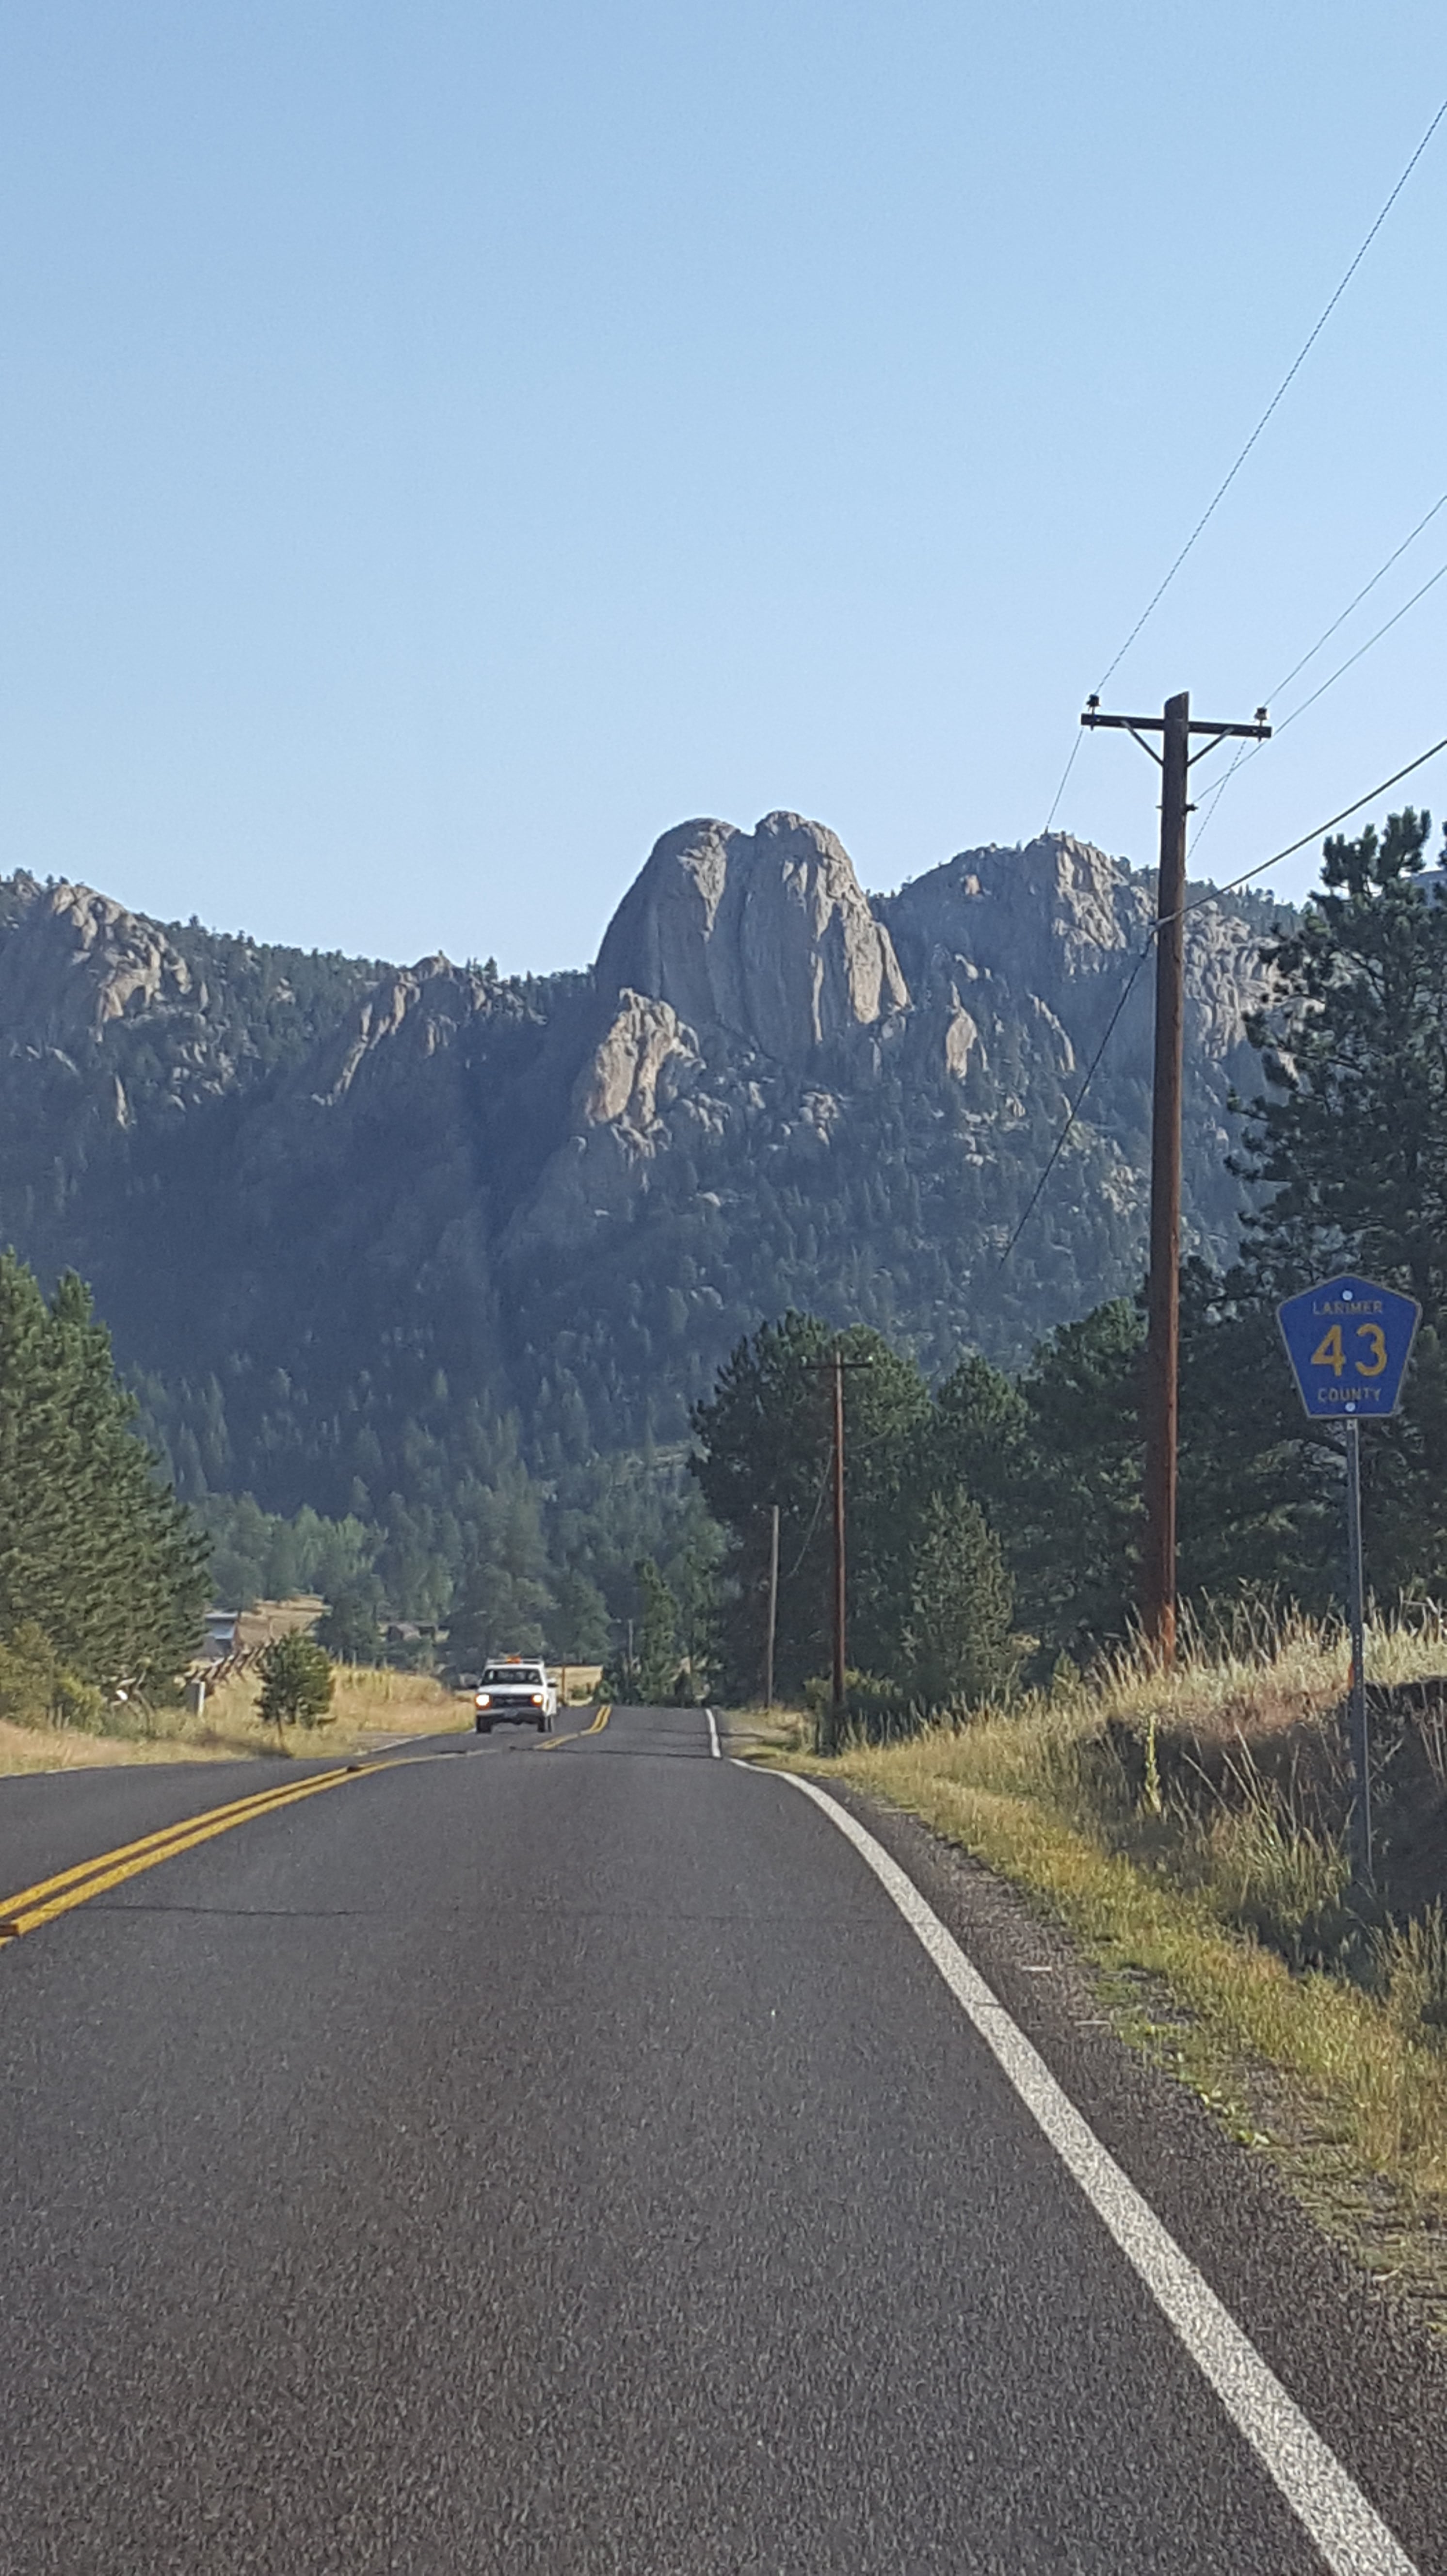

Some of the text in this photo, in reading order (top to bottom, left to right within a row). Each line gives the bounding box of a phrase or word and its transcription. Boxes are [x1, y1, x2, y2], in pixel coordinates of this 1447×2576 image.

[1313, 1300, 1382, 1315] LARIMER
[1311, 1323, 1387, 1377] 43
[1317, 1387, 1382, 1402] COUNTY
